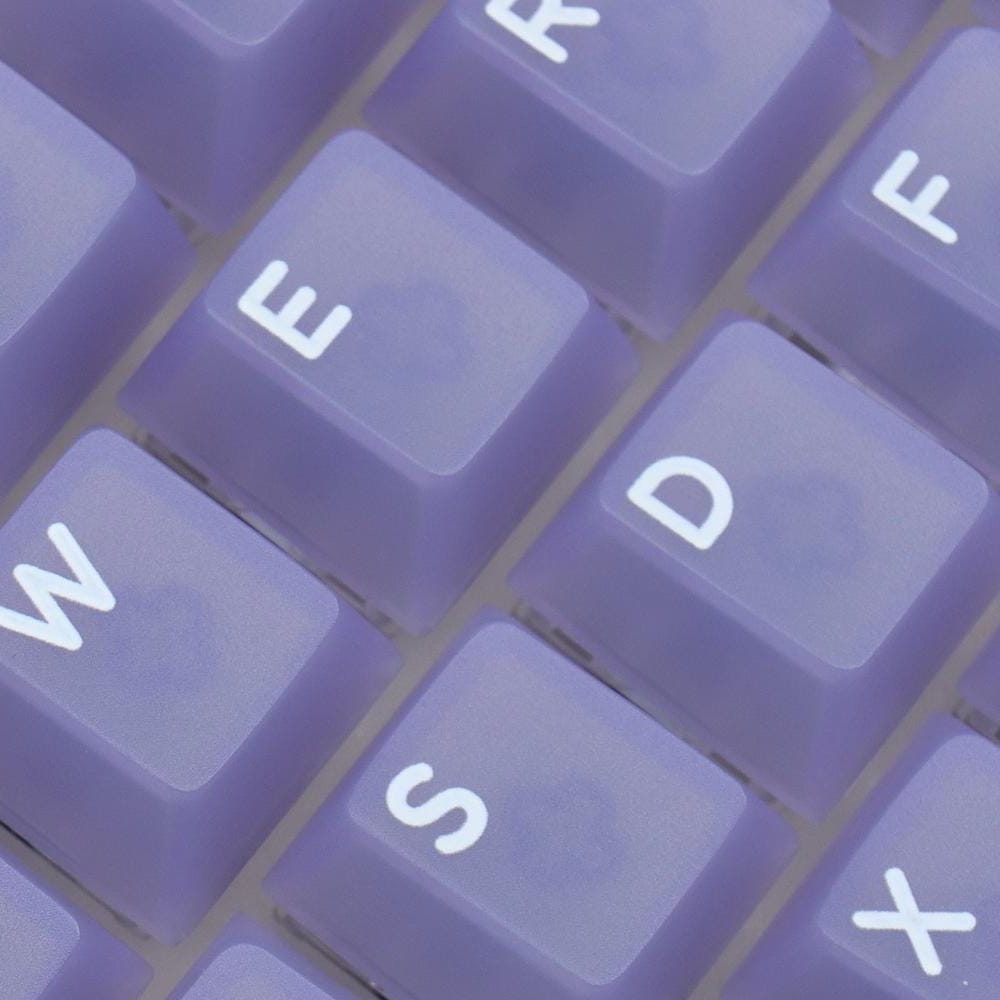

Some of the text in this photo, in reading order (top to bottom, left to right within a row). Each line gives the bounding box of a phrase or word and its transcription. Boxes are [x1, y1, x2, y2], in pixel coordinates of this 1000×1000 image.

[485, 0, 601, 64] R
[872, 150, 958, 244] F
[237, 260, 353, 360] E
[626, 456, 734, 550] D
[385, 761, 489, 855] S
[851, 867, 977, 976] X
